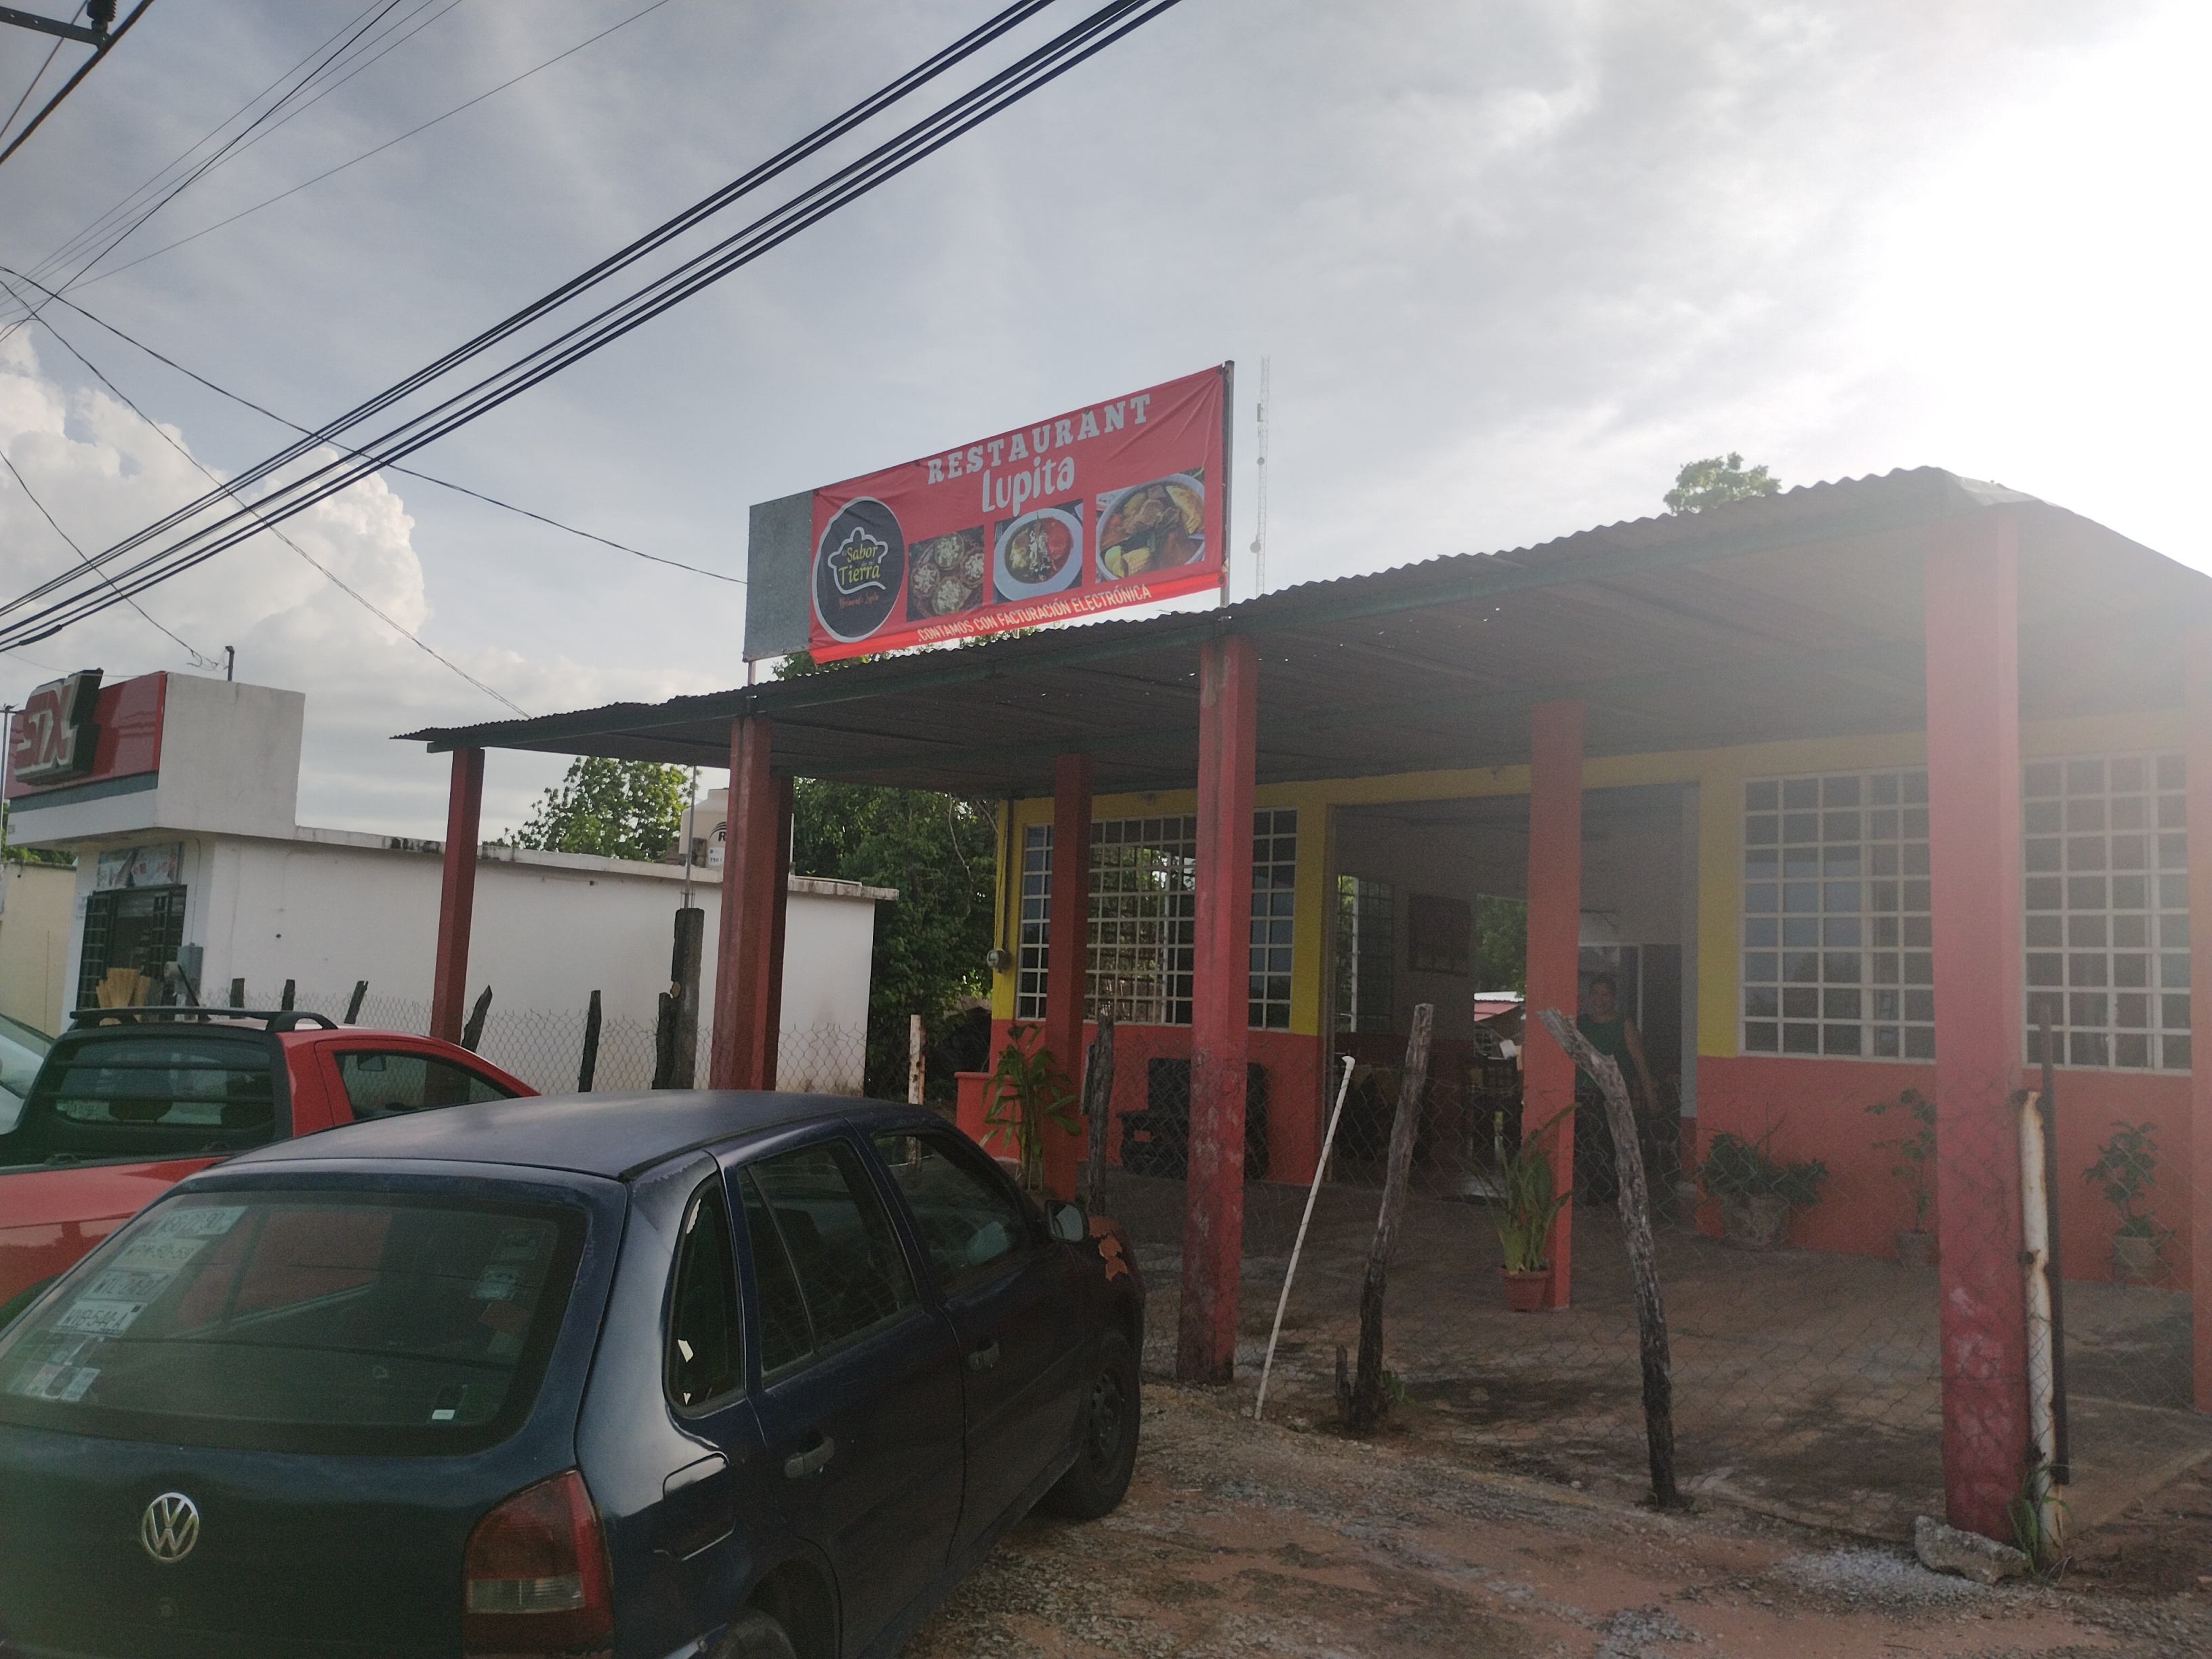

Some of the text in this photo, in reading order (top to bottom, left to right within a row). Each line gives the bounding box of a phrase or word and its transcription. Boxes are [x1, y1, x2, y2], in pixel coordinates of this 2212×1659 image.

[928, 394, 1150, 485] RESTAURANT
[982, 456, 1075, 517] Lupita
[838, 565, 881, 586] Tierra
[847, 544, 878, 562] Sabor
[918, 583, 1152, 642] CONTAMOS CON FACTURACIÓN ELECTRÓNICA
[14, 680, 74, 773] SIX
